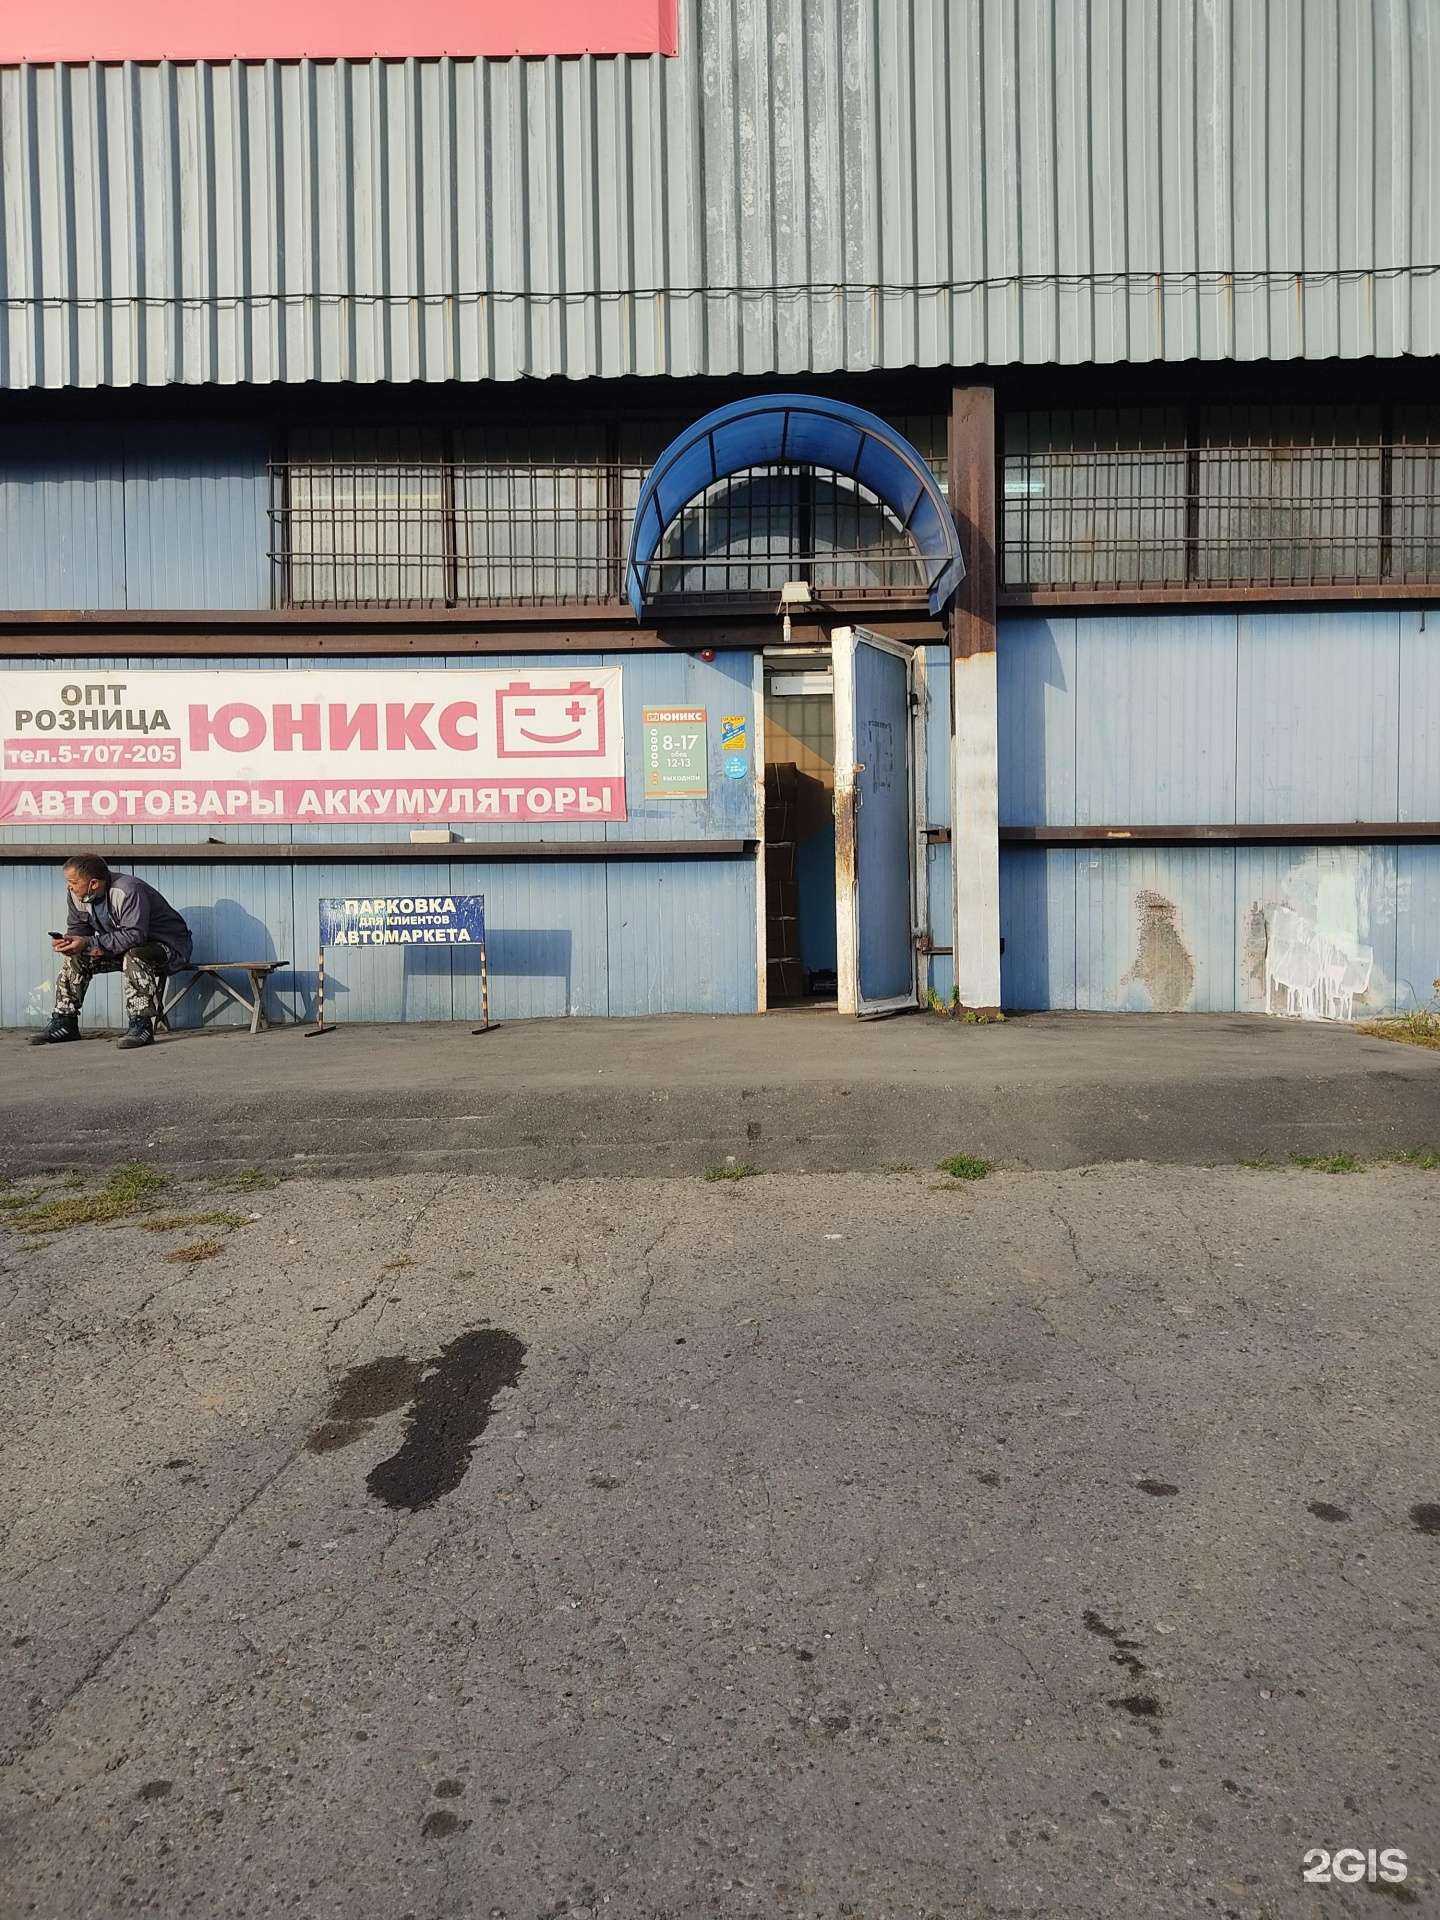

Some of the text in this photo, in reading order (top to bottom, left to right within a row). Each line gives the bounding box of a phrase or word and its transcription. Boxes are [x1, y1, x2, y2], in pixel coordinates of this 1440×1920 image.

[61, 684, 127, 706] ОПТ
[15, 709, 171, 734] РОЗНИЦА
[659, 712, 702, 721] ЮНИКС
[188, 702, 478, 752] ЮНИКС
[662, 735, 699, 750] 8-17
[9, 744, 177, 764] тел.5-707-205
[667, 758, 691, 768] 12-13
[14, 786, 612, 817] АВТОТОВАРЫ АККУМУЛЯТОРЫ
[344, 897, 457, 915] ПАРКОВКА
[386, 915, 450, 926] КЛИЕНТОВ
[334, 928, 471, 944] АВТОМАРКЕТА
